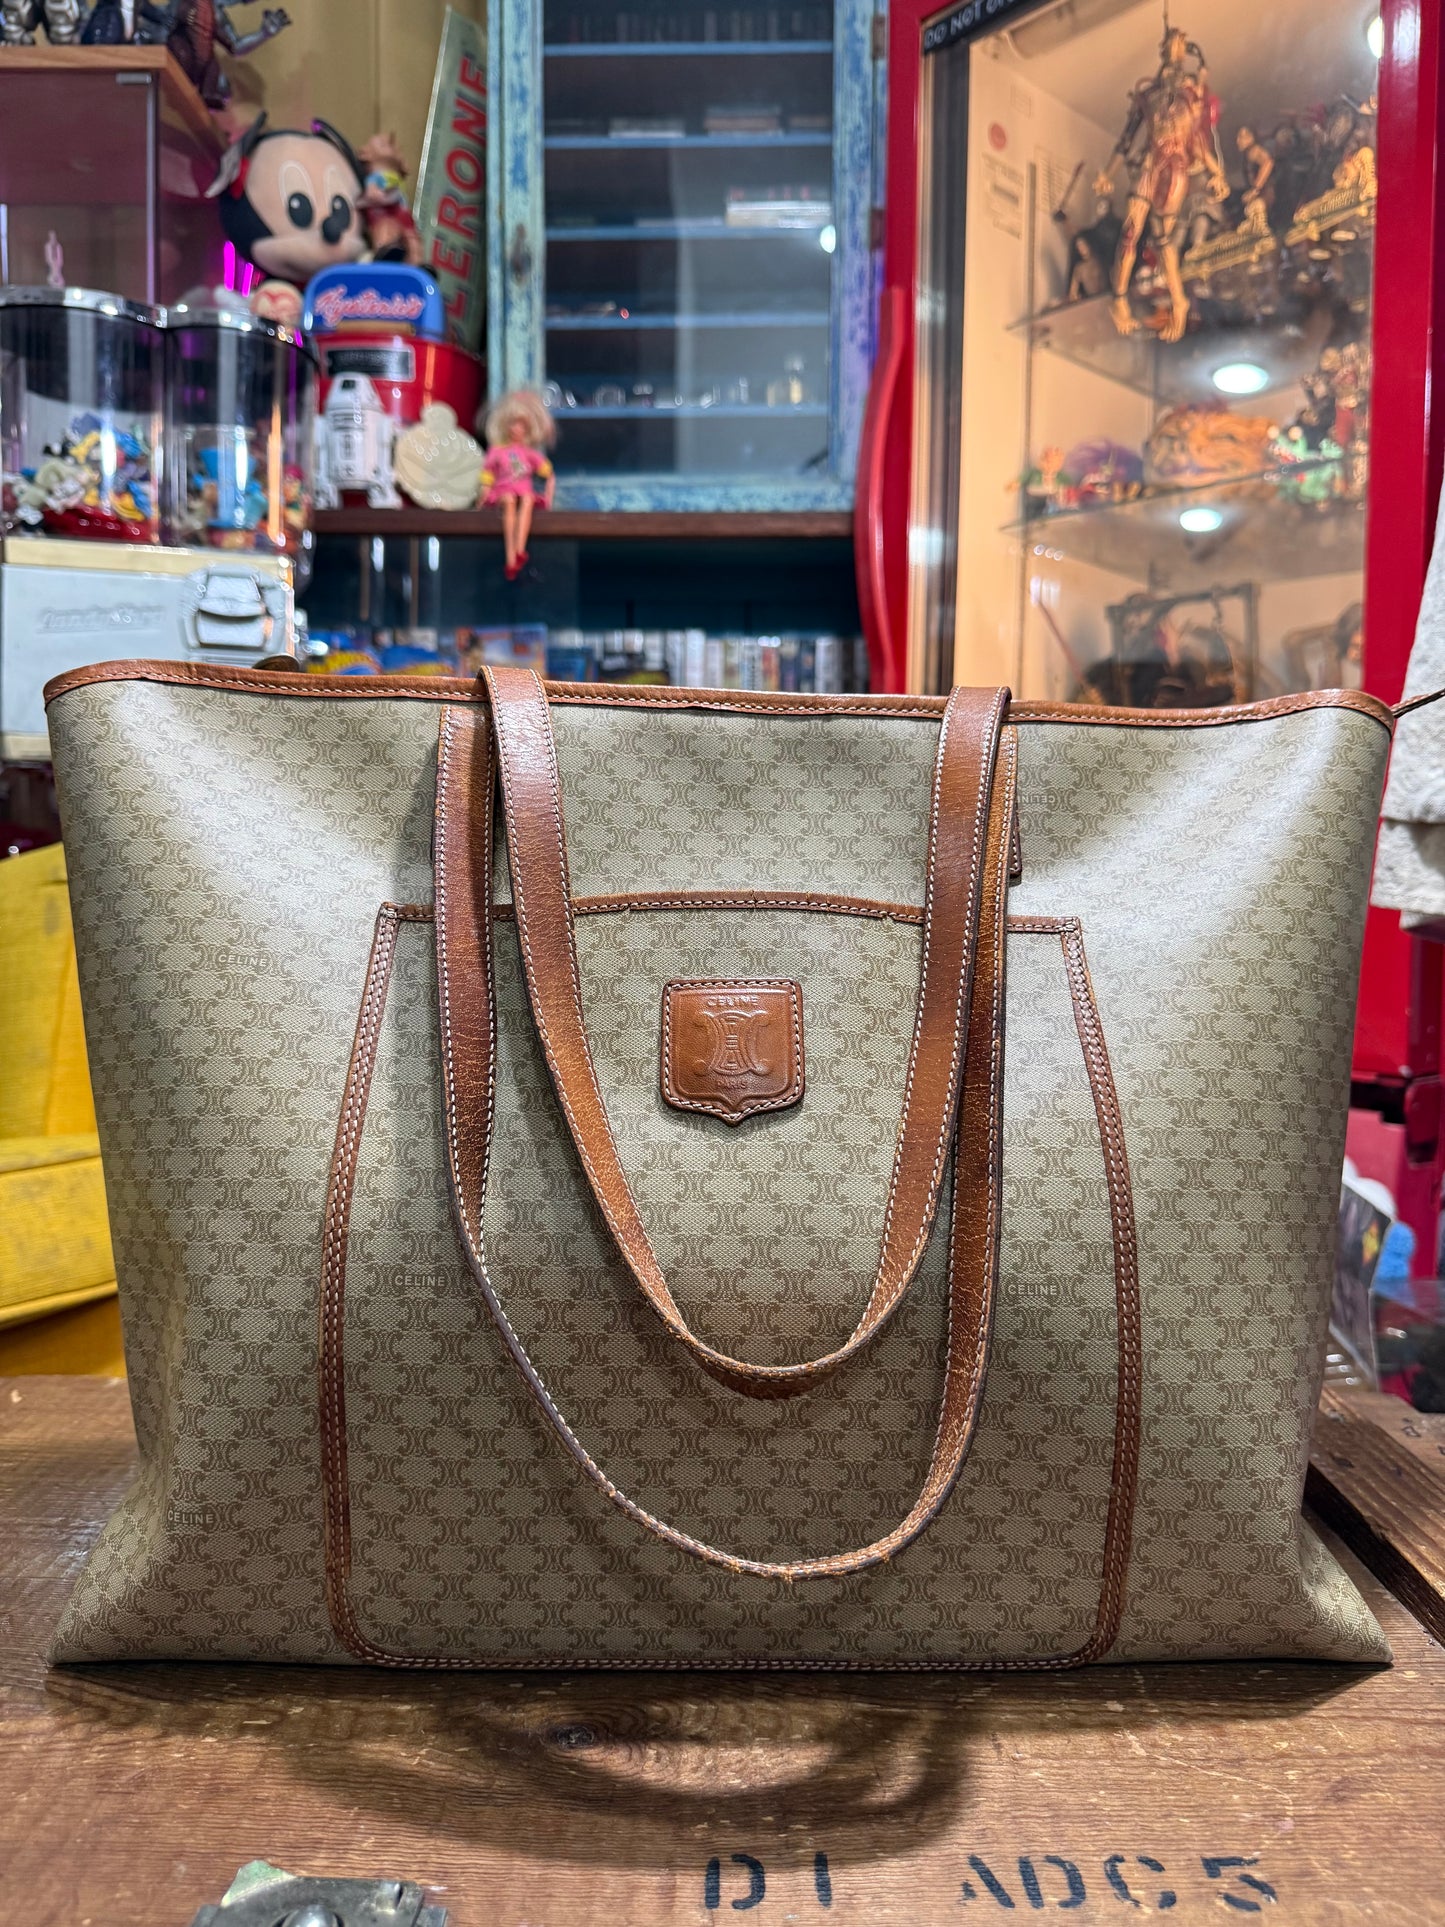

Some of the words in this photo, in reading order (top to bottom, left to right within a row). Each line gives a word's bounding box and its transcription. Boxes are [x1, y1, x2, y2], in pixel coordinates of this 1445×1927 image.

[950, 0, 983, 35] NOT
[431, 54, 488, 322] LERONE
[1017, 794, 1056, 804] CELIN
[217, 953, 269, 967] CELINE
[704, 995, 760, 1007] CELINE
[394, 1274, 446, 1287] CELINE
[1007, 1283, 1058, 1296] CELINE
[167, 1509, 214, 1524] CELINE
